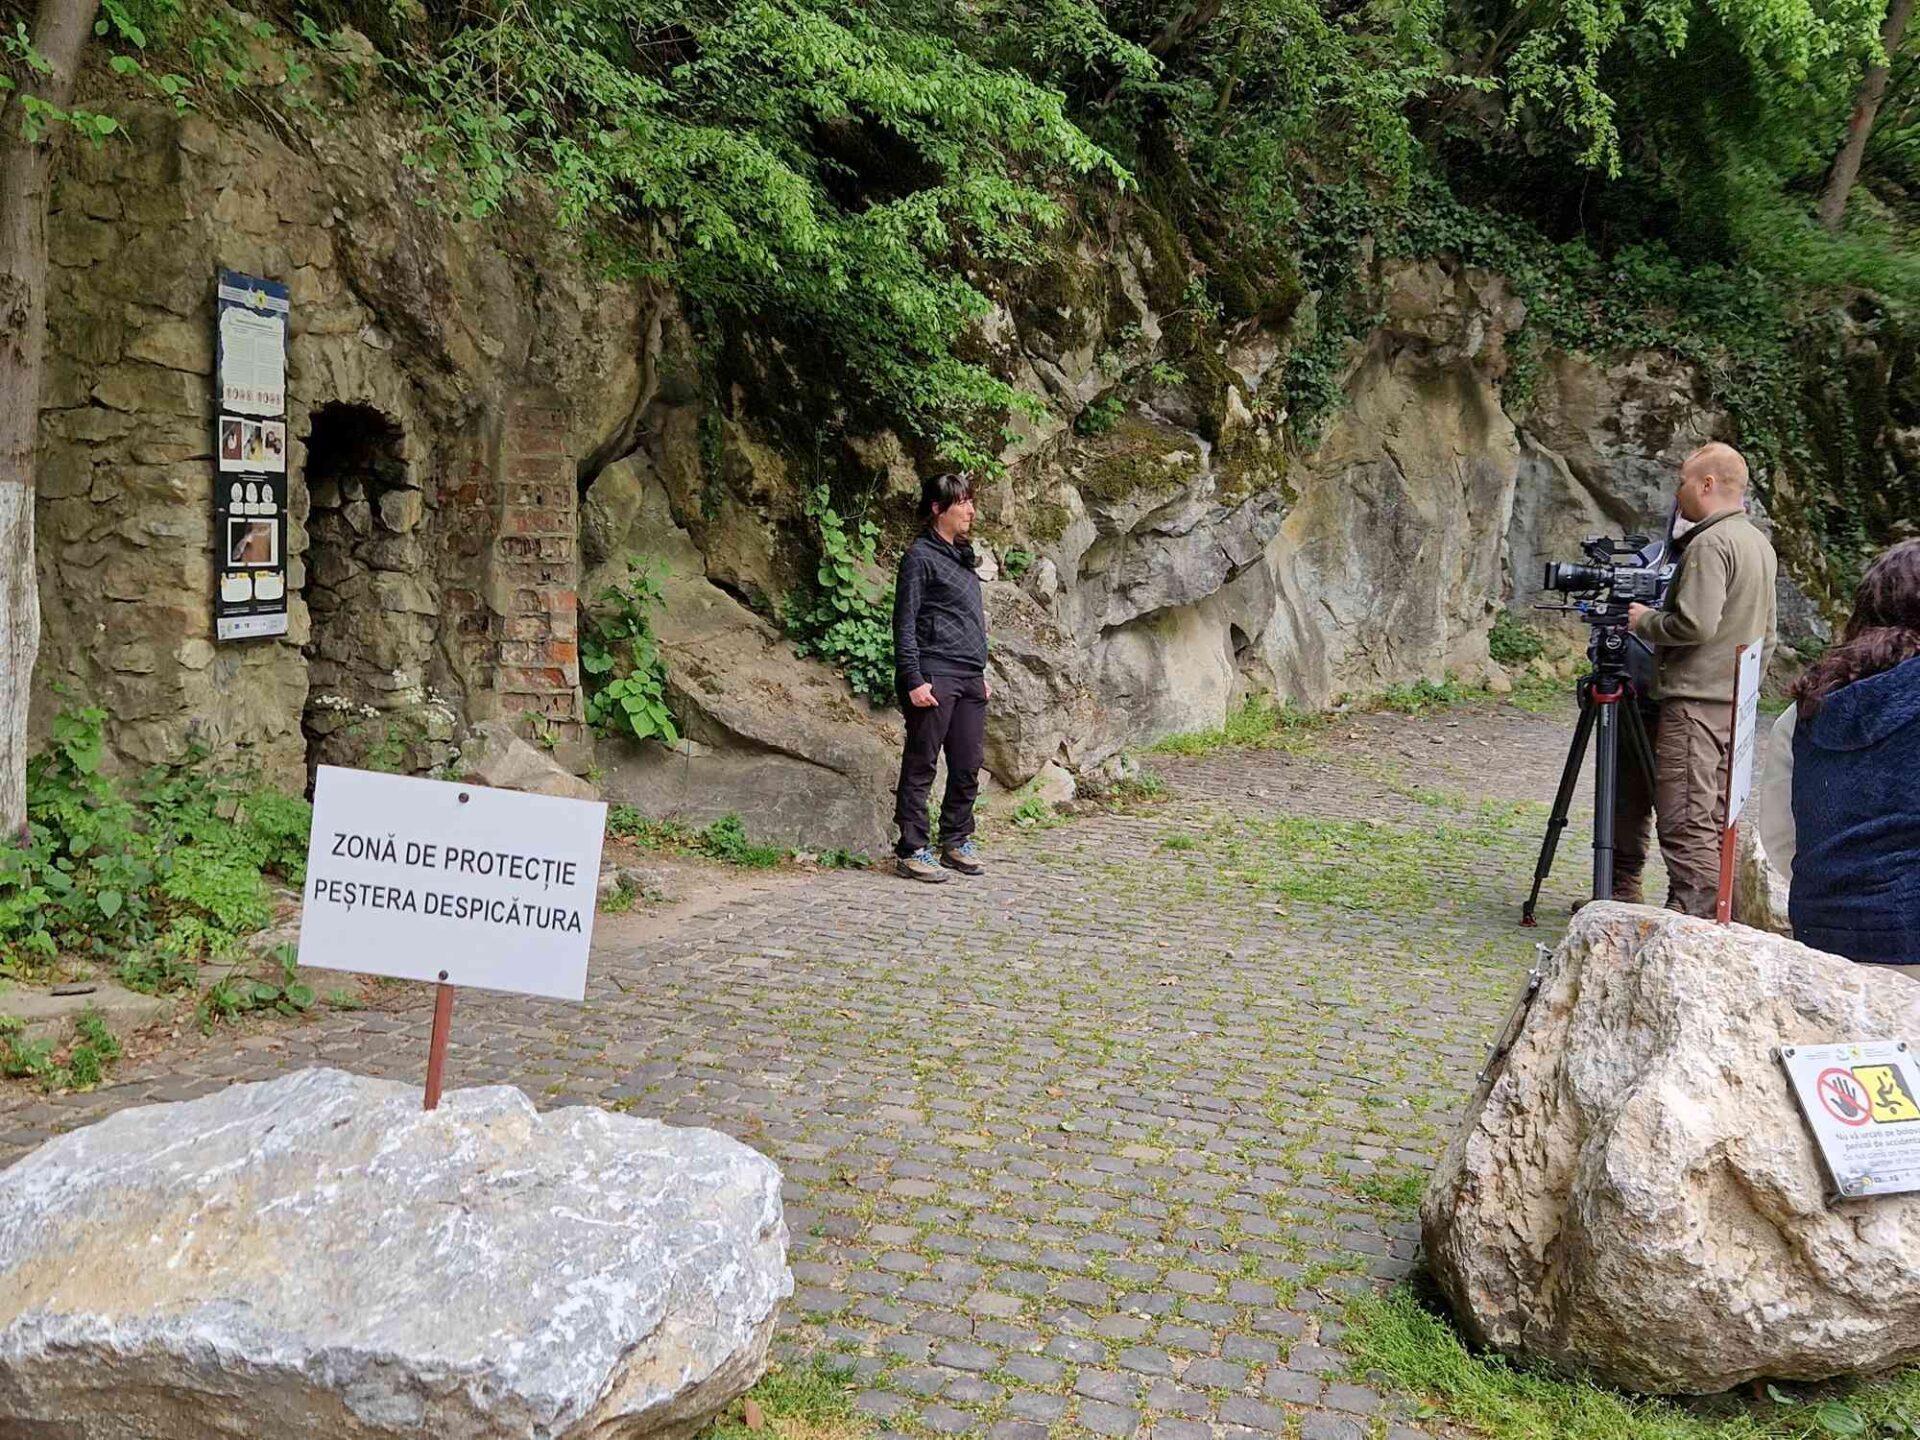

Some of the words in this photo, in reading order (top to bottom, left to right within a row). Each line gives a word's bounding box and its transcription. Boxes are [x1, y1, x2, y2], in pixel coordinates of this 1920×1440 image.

[332, 832, 398, 864] ZONĂ
[405, 842, 437, 869] DE
[443, 846, 577, 892] PROTECȚIE
[314, 878, 417, 913] PEȘTERA
[424, 891, 583, 934] DESPICĂTURA
